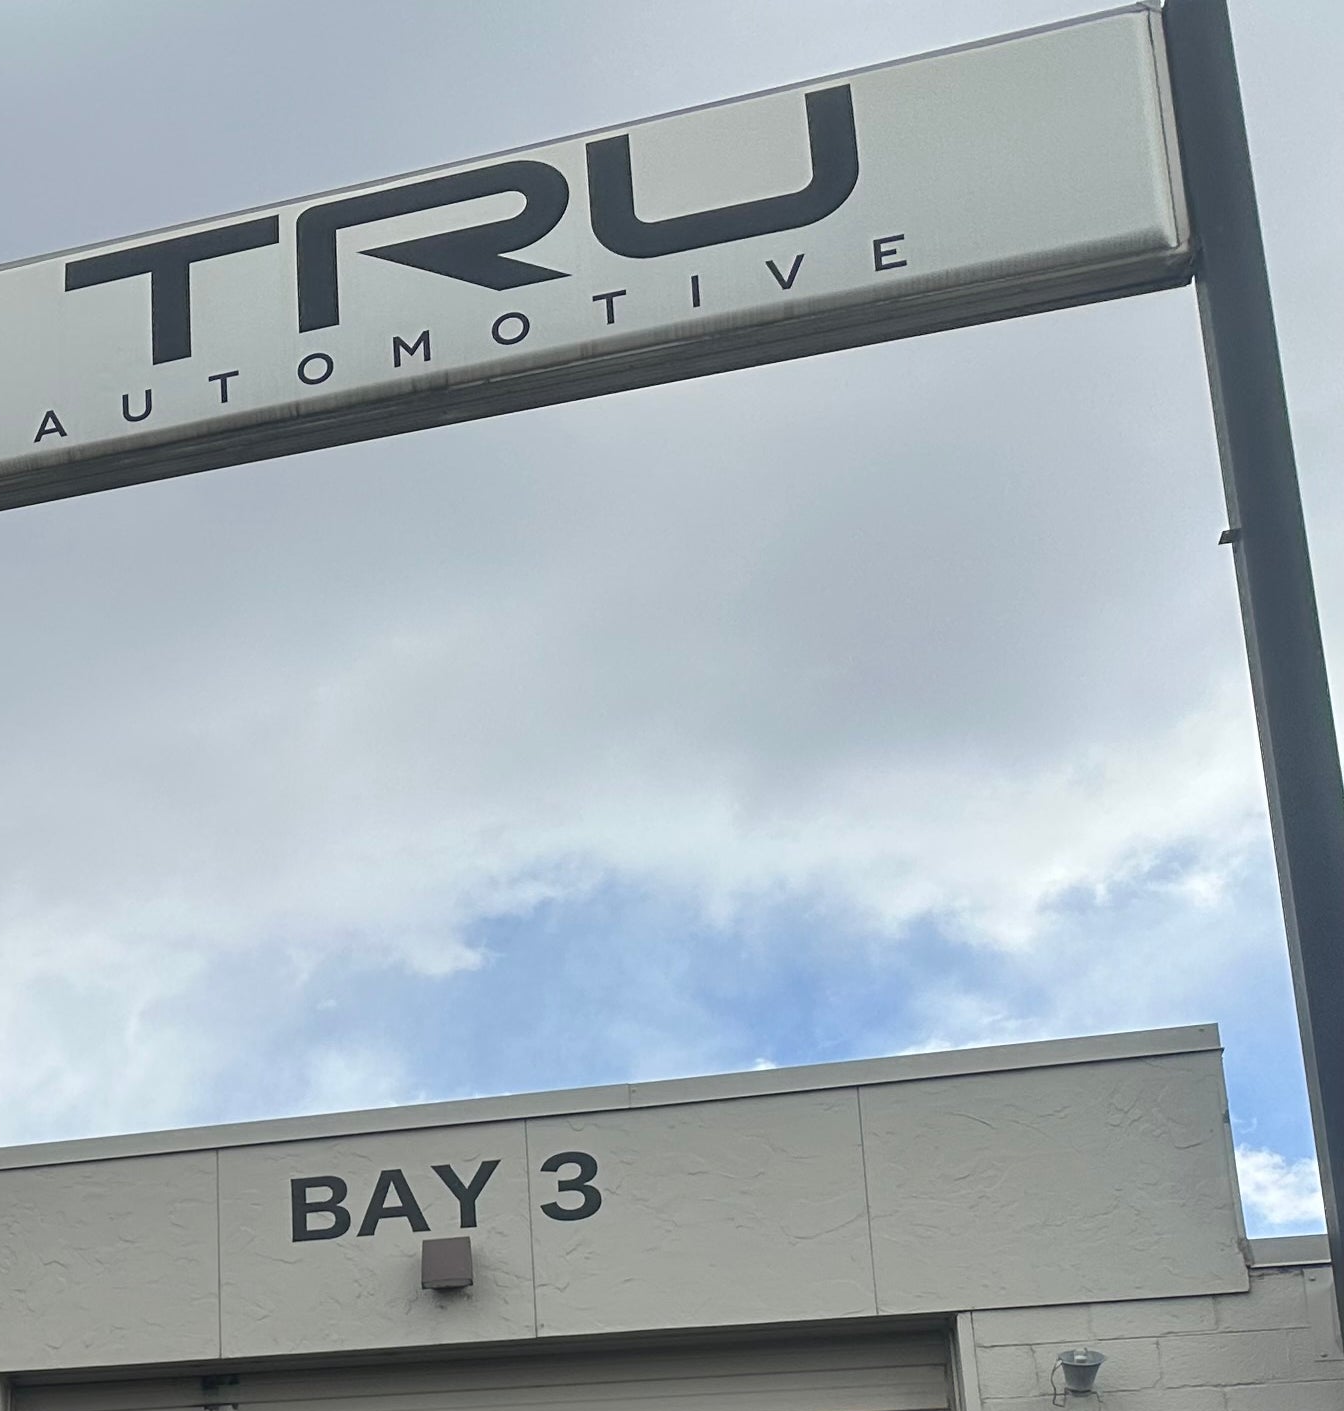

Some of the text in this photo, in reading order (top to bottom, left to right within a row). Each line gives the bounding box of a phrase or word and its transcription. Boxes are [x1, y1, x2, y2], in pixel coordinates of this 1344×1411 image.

[64, 83, 860, 366] TRU
[33, 233, 908, 443] AUTOMOTIVE
[289, 1151, 603, 1243] BAY 3
